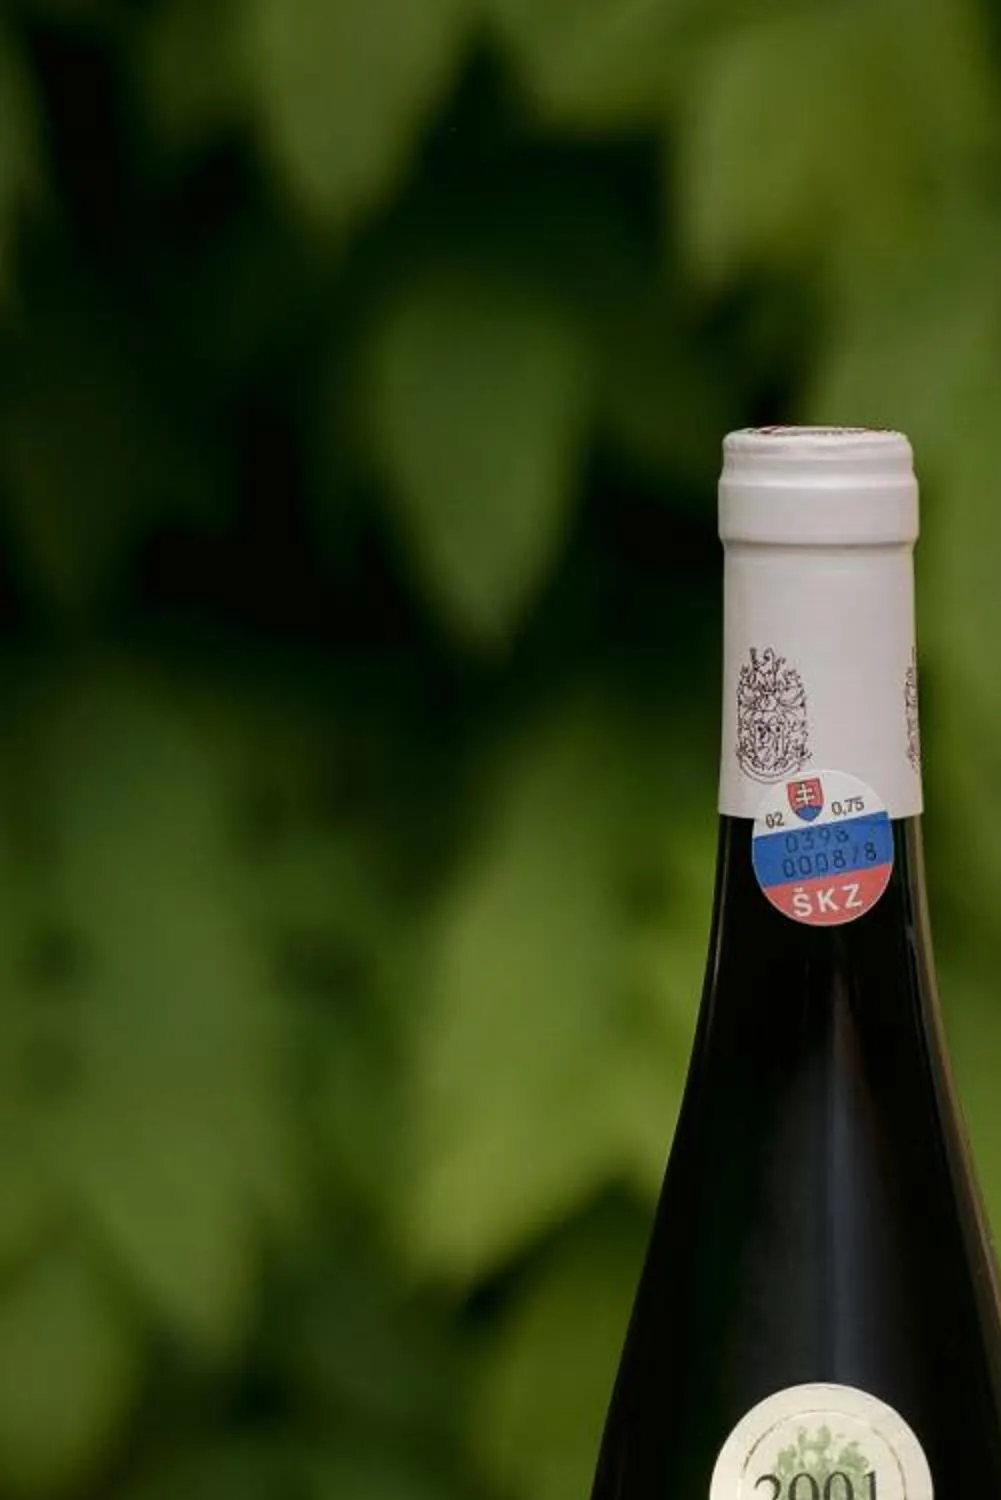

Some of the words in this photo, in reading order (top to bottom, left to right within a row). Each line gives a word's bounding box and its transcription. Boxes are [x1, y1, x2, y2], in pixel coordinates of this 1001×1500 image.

[831, 795, 865, 816] 0,75
[765, 811, 785, 828] 02
[793, 883, 862, 917] ŠKZ
